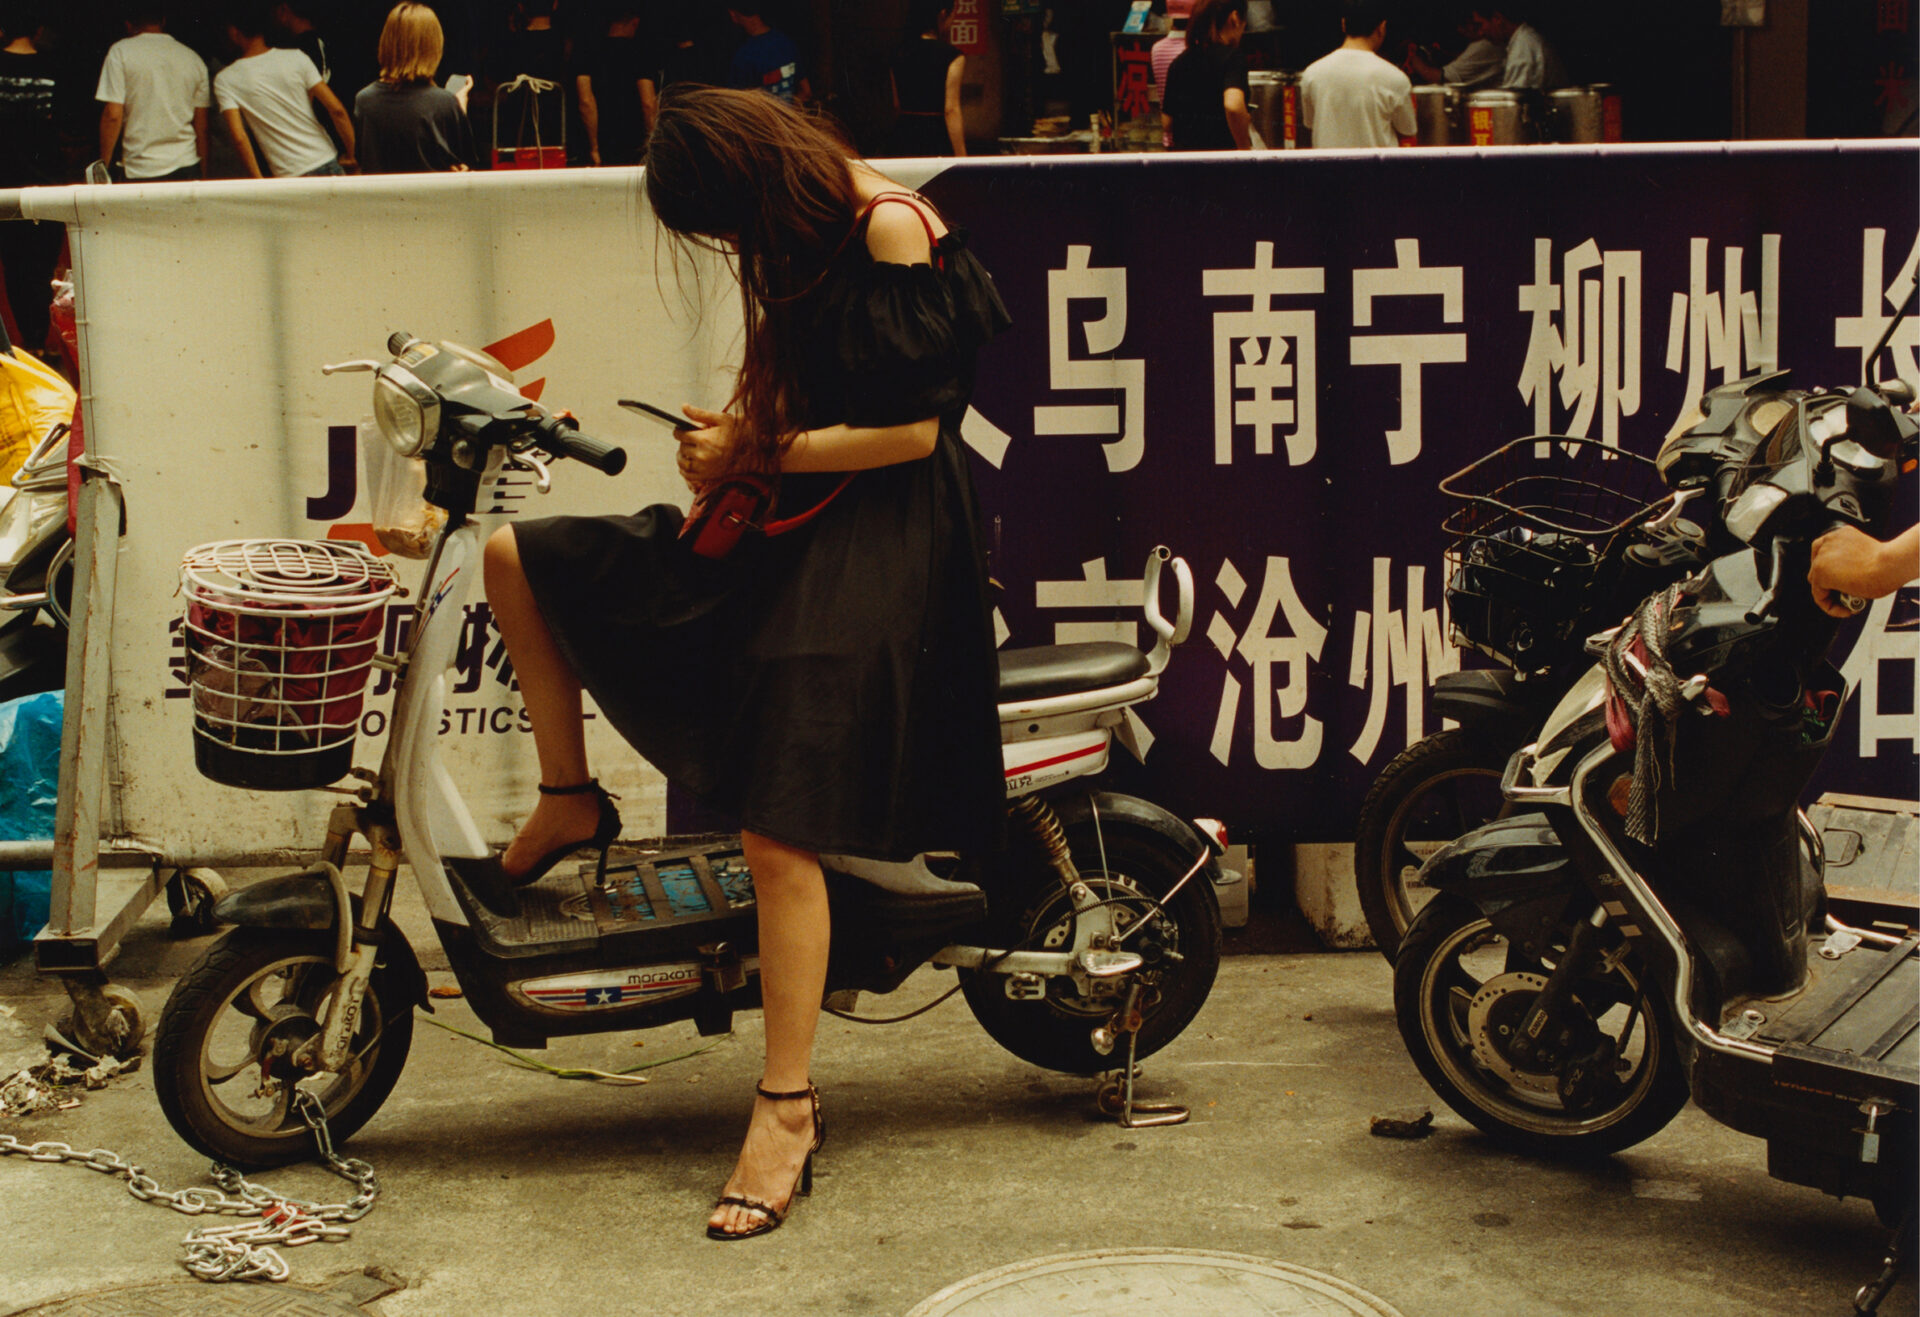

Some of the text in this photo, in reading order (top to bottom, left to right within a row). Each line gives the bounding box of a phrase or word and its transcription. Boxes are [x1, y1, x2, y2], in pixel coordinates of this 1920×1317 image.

[961, 245, 1146, 473] 乌
[1202, 238, 1467, 466] 南宁
[1517, 234, 1781, 460] 柳州
[1206, 553, 1461, 770] 沧州
